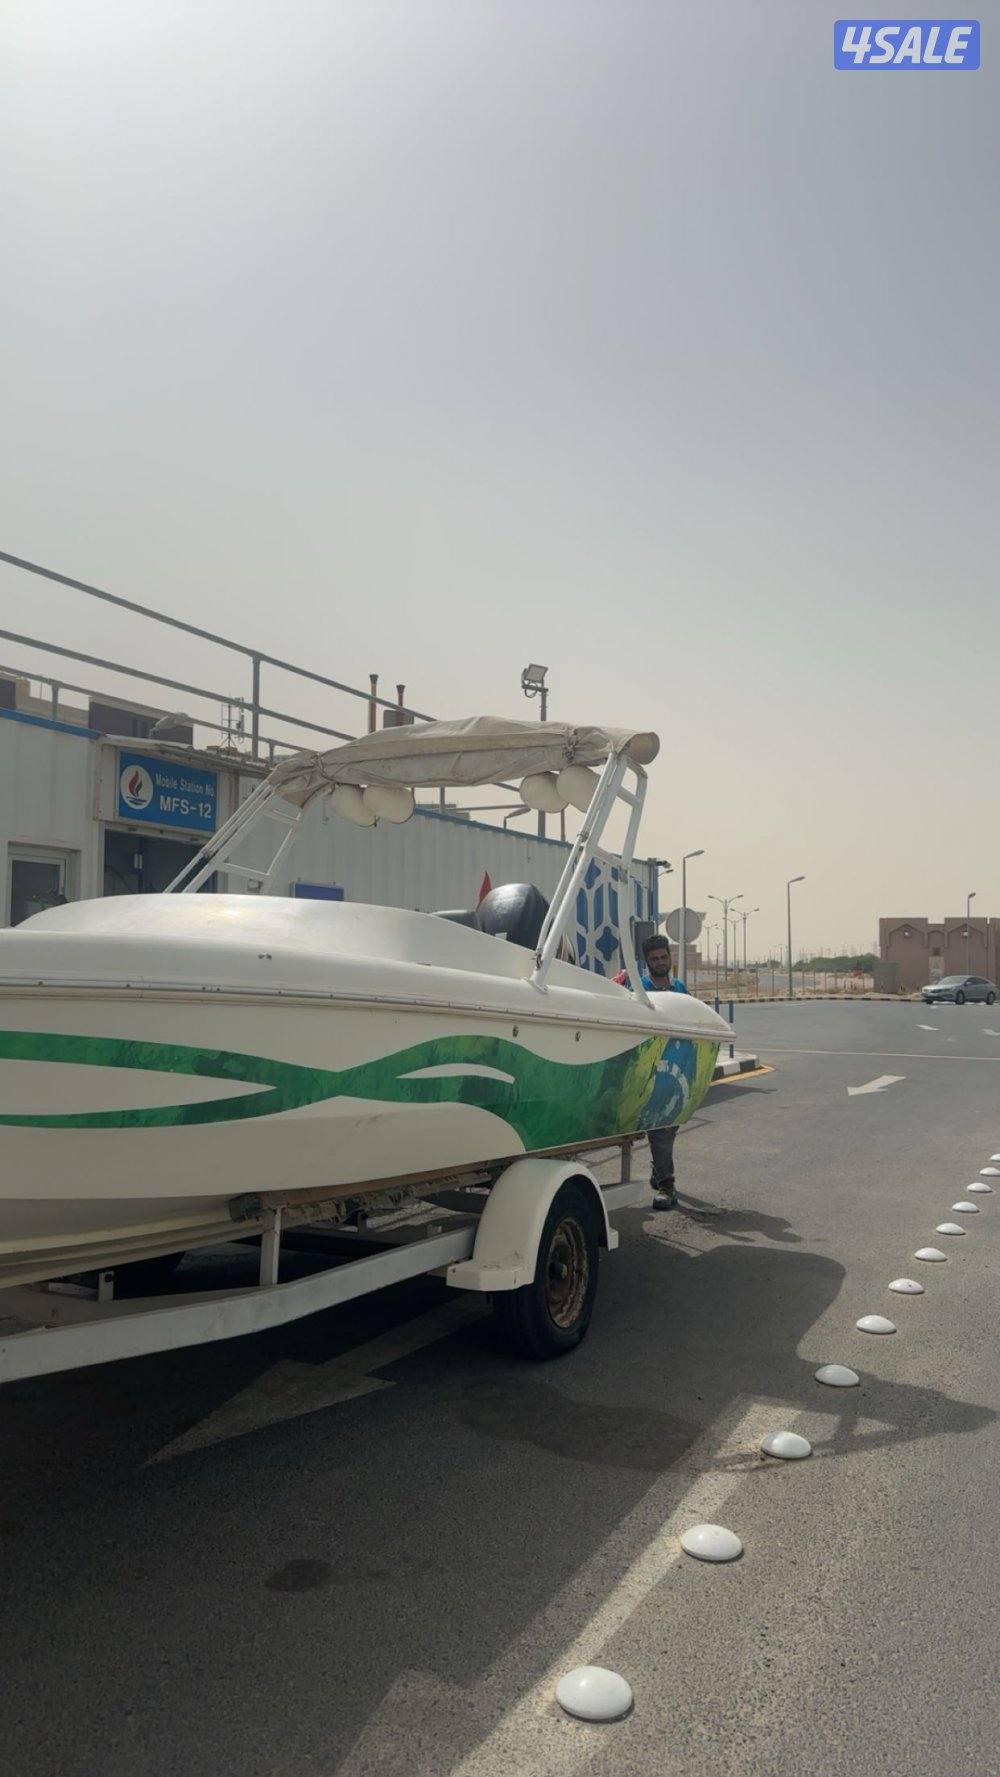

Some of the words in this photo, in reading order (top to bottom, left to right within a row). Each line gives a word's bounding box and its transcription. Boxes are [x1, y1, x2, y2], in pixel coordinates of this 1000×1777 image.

[155, 773, 178, 789] Mobile
[180, 779, 204, 794] Station
[160, 795, 212, 818] MFS-12
